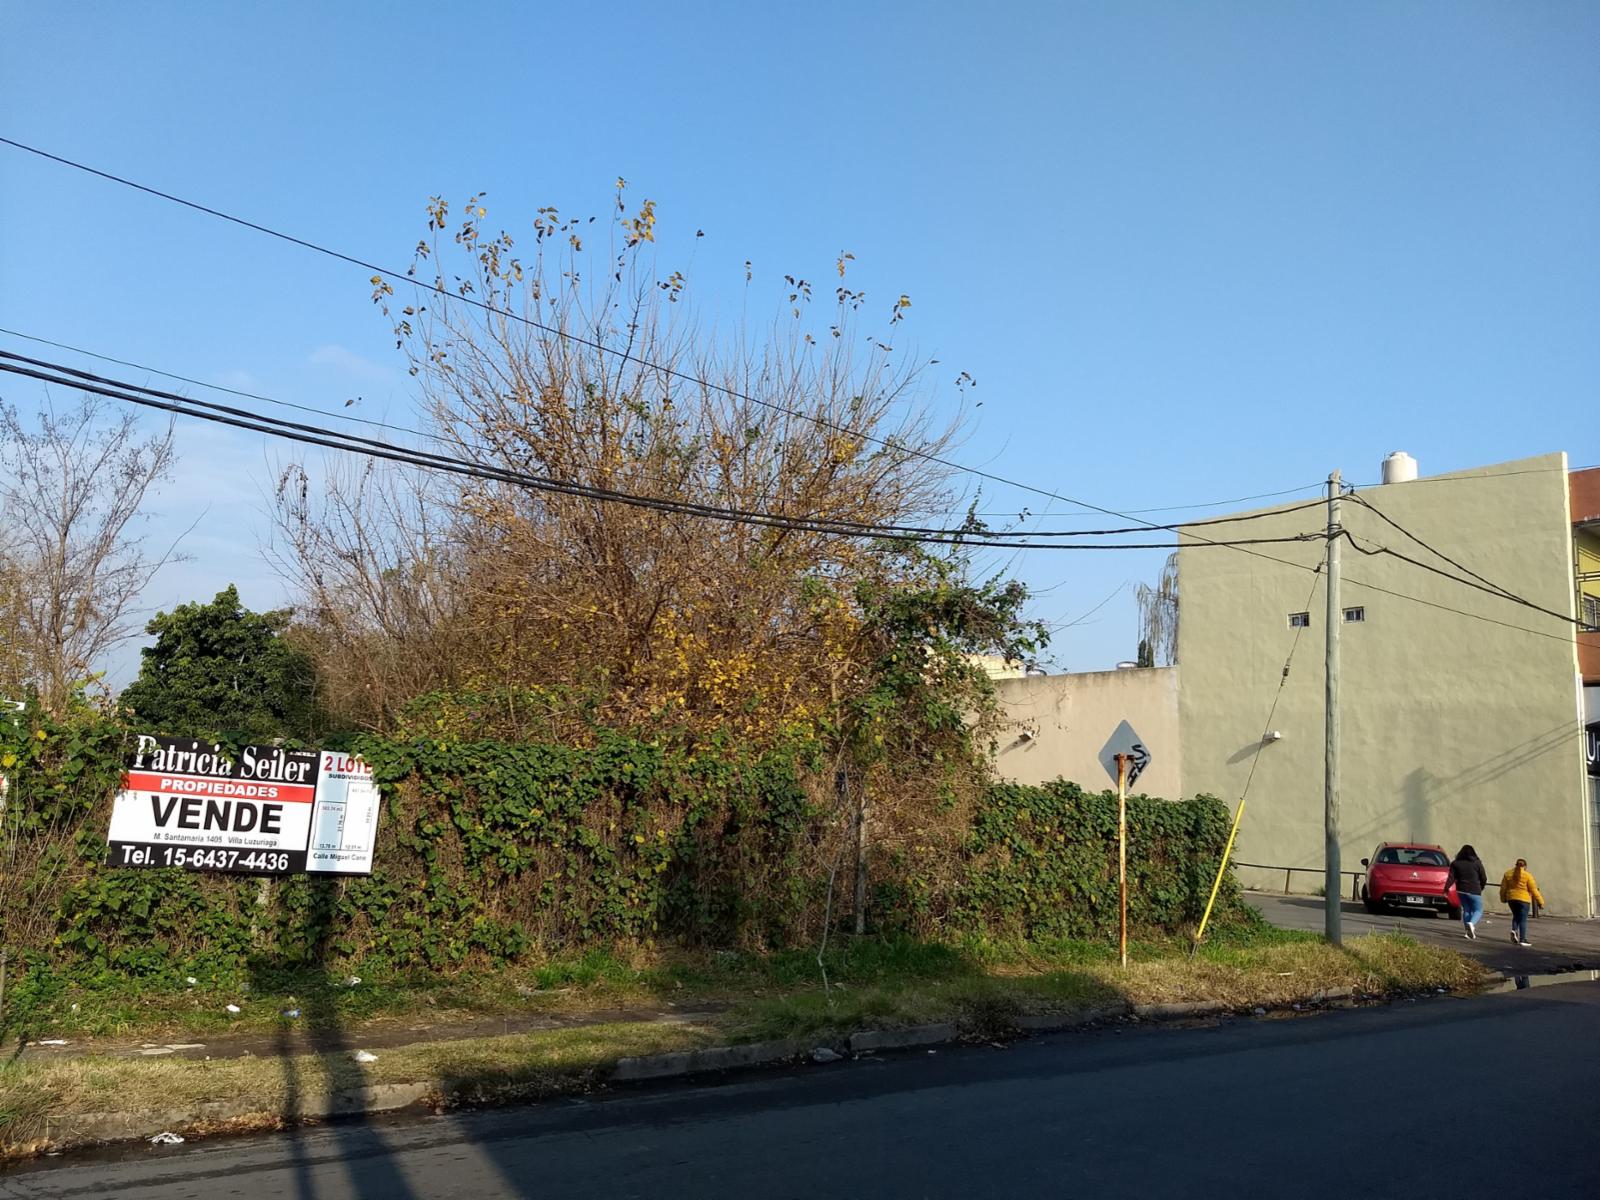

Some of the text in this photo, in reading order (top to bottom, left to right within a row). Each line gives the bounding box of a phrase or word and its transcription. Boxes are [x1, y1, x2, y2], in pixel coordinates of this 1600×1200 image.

[133, 735, 311, 782] Patricia Seiler
[324, 755, 373, 774] 2 LOTE
[160, 778, 279, 798] PROPIEDADES
[151, 795, 284, 835] VENDE
[153, 832, 161, 840] M.
[206, 836, 223, 844] 1405
[228, 836, 243, 845] Villa
[244, 838, 277, 848] Luzuriaga
[121, 845, 289, 871] Tel. 15-6437-4436
[313, 852, 328, 860] Calle
[329, 853, 350, 861] Miguel
